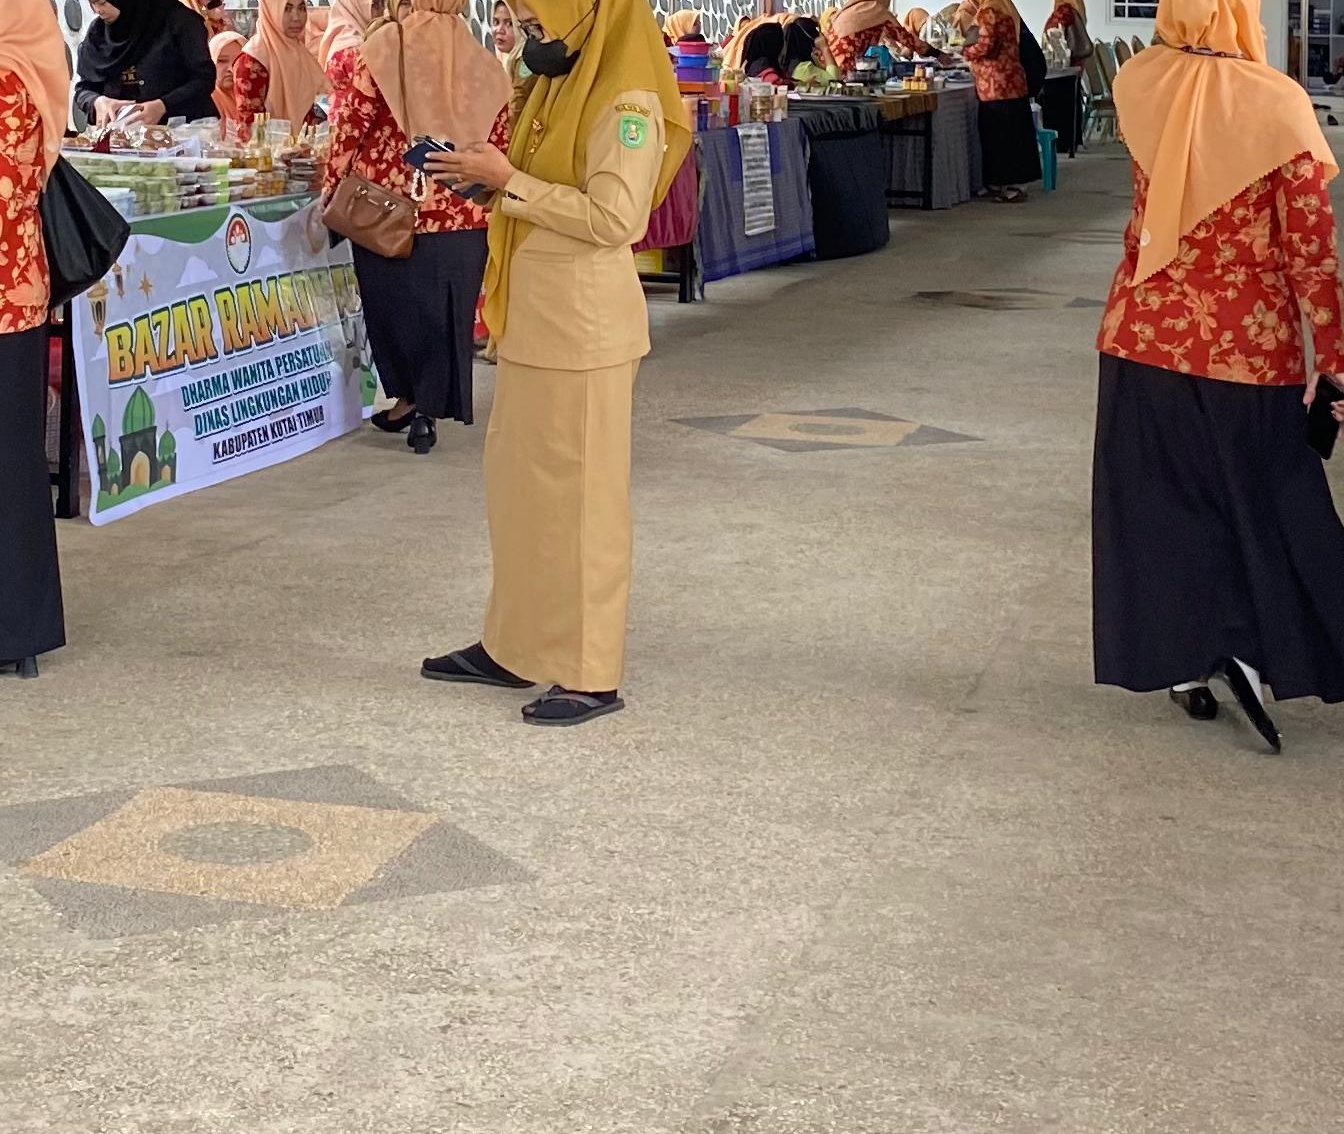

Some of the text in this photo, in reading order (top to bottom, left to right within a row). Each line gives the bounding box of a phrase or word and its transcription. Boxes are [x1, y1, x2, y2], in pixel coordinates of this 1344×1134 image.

[105, 294, 218, 385] BAZAR
[181, 377, 231, 408] DHARMA
[230, 363, 276, 395] WANITA
[194, 371, 332, 436] DINAS LINGKUNGAN HIDUP
[213, 406, 325, 460] KABUPATEN KUTAI TIMUR
